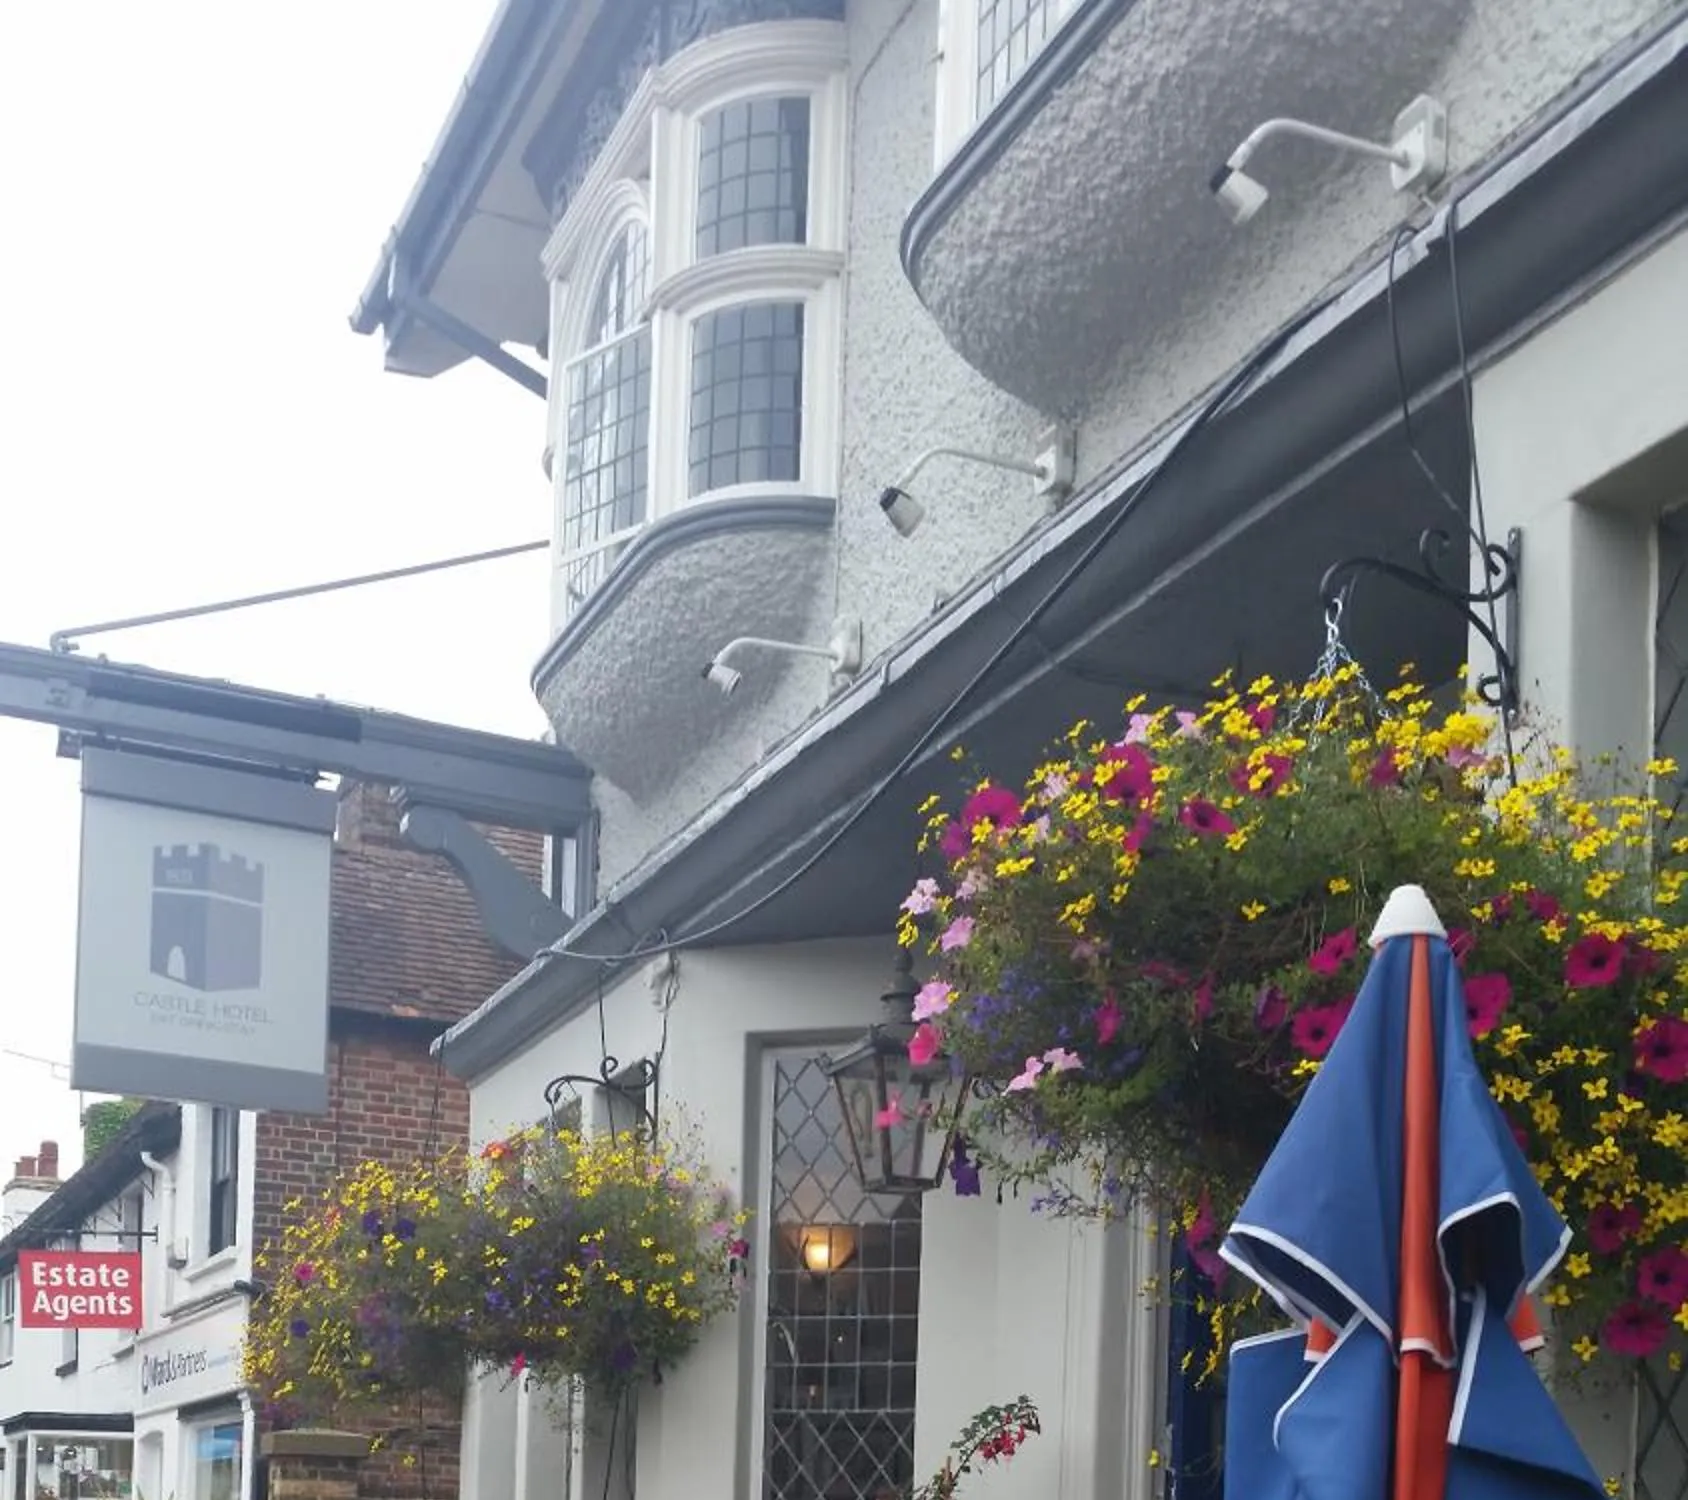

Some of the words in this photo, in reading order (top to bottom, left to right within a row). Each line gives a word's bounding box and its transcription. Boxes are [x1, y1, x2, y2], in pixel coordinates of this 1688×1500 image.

[134, 991, 206, 1015] CASTLE
[213, 1000, 271, 1023] HOTEL
[32, 1261, 129, 1287] Estate
[32, 1290, 133, 1321] Agents
